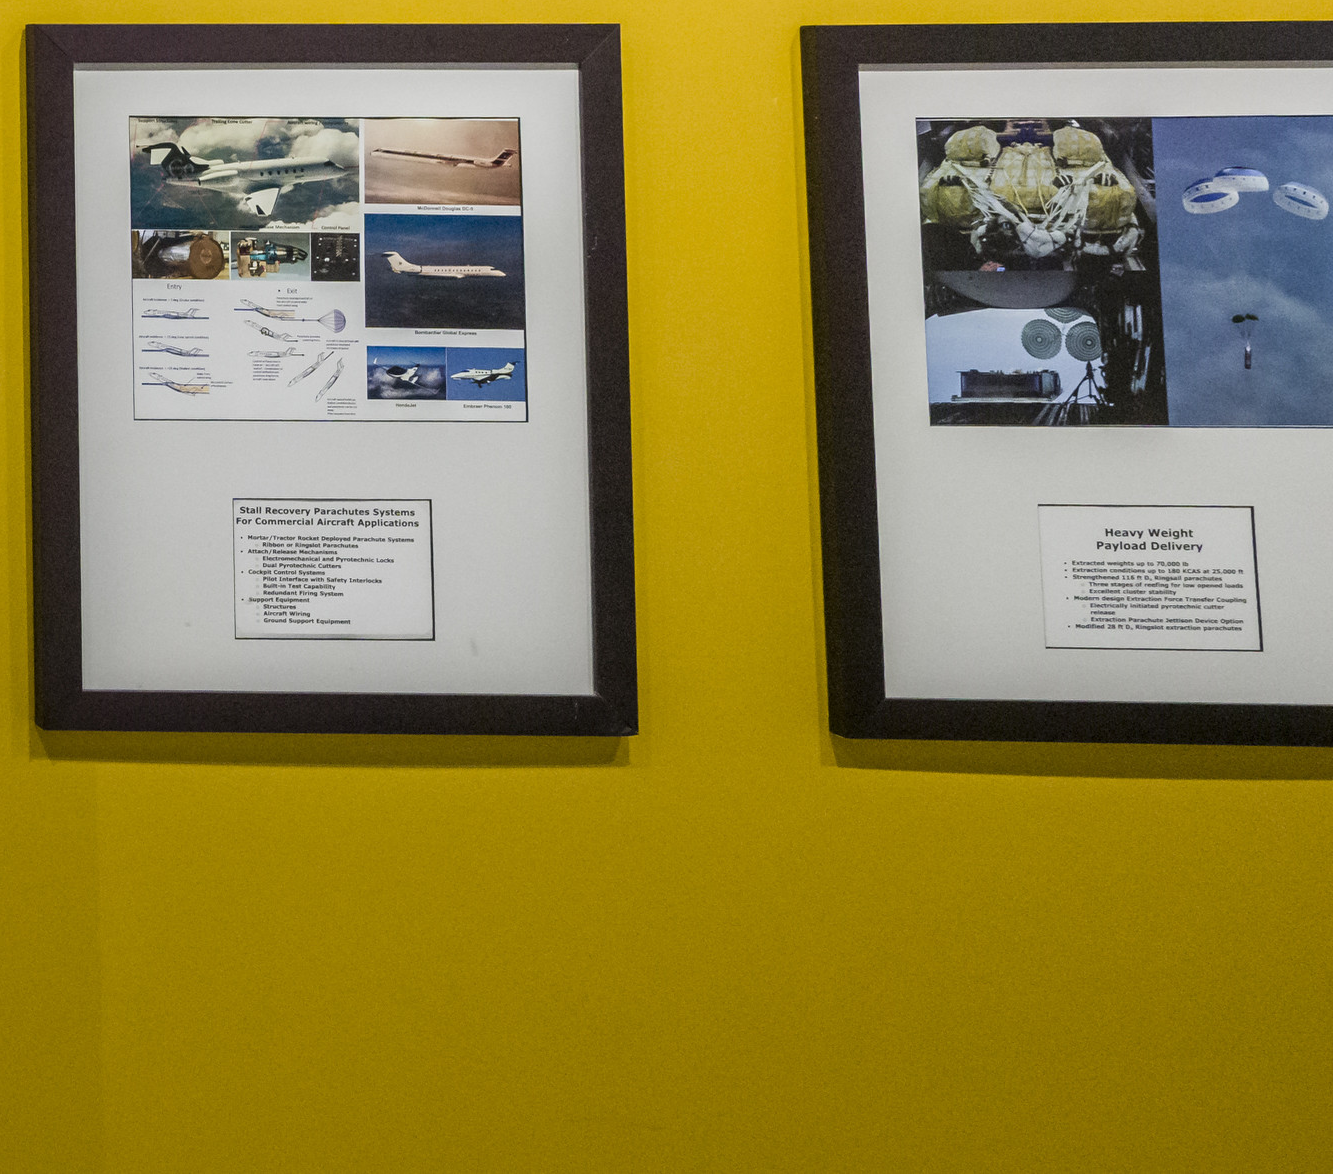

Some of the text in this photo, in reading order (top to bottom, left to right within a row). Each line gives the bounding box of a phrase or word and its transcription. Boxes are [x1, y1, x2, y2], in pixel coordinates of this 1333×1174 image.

[239, 506, 415, 517] Stall Recovery Parachutes Systems
[236, 517, 419, 528] For Commercial Aircraft Applications
[1104, 528, 1193, 540] Heavy Weight
[1096, 541, 1203, 553] Payload Delivery
